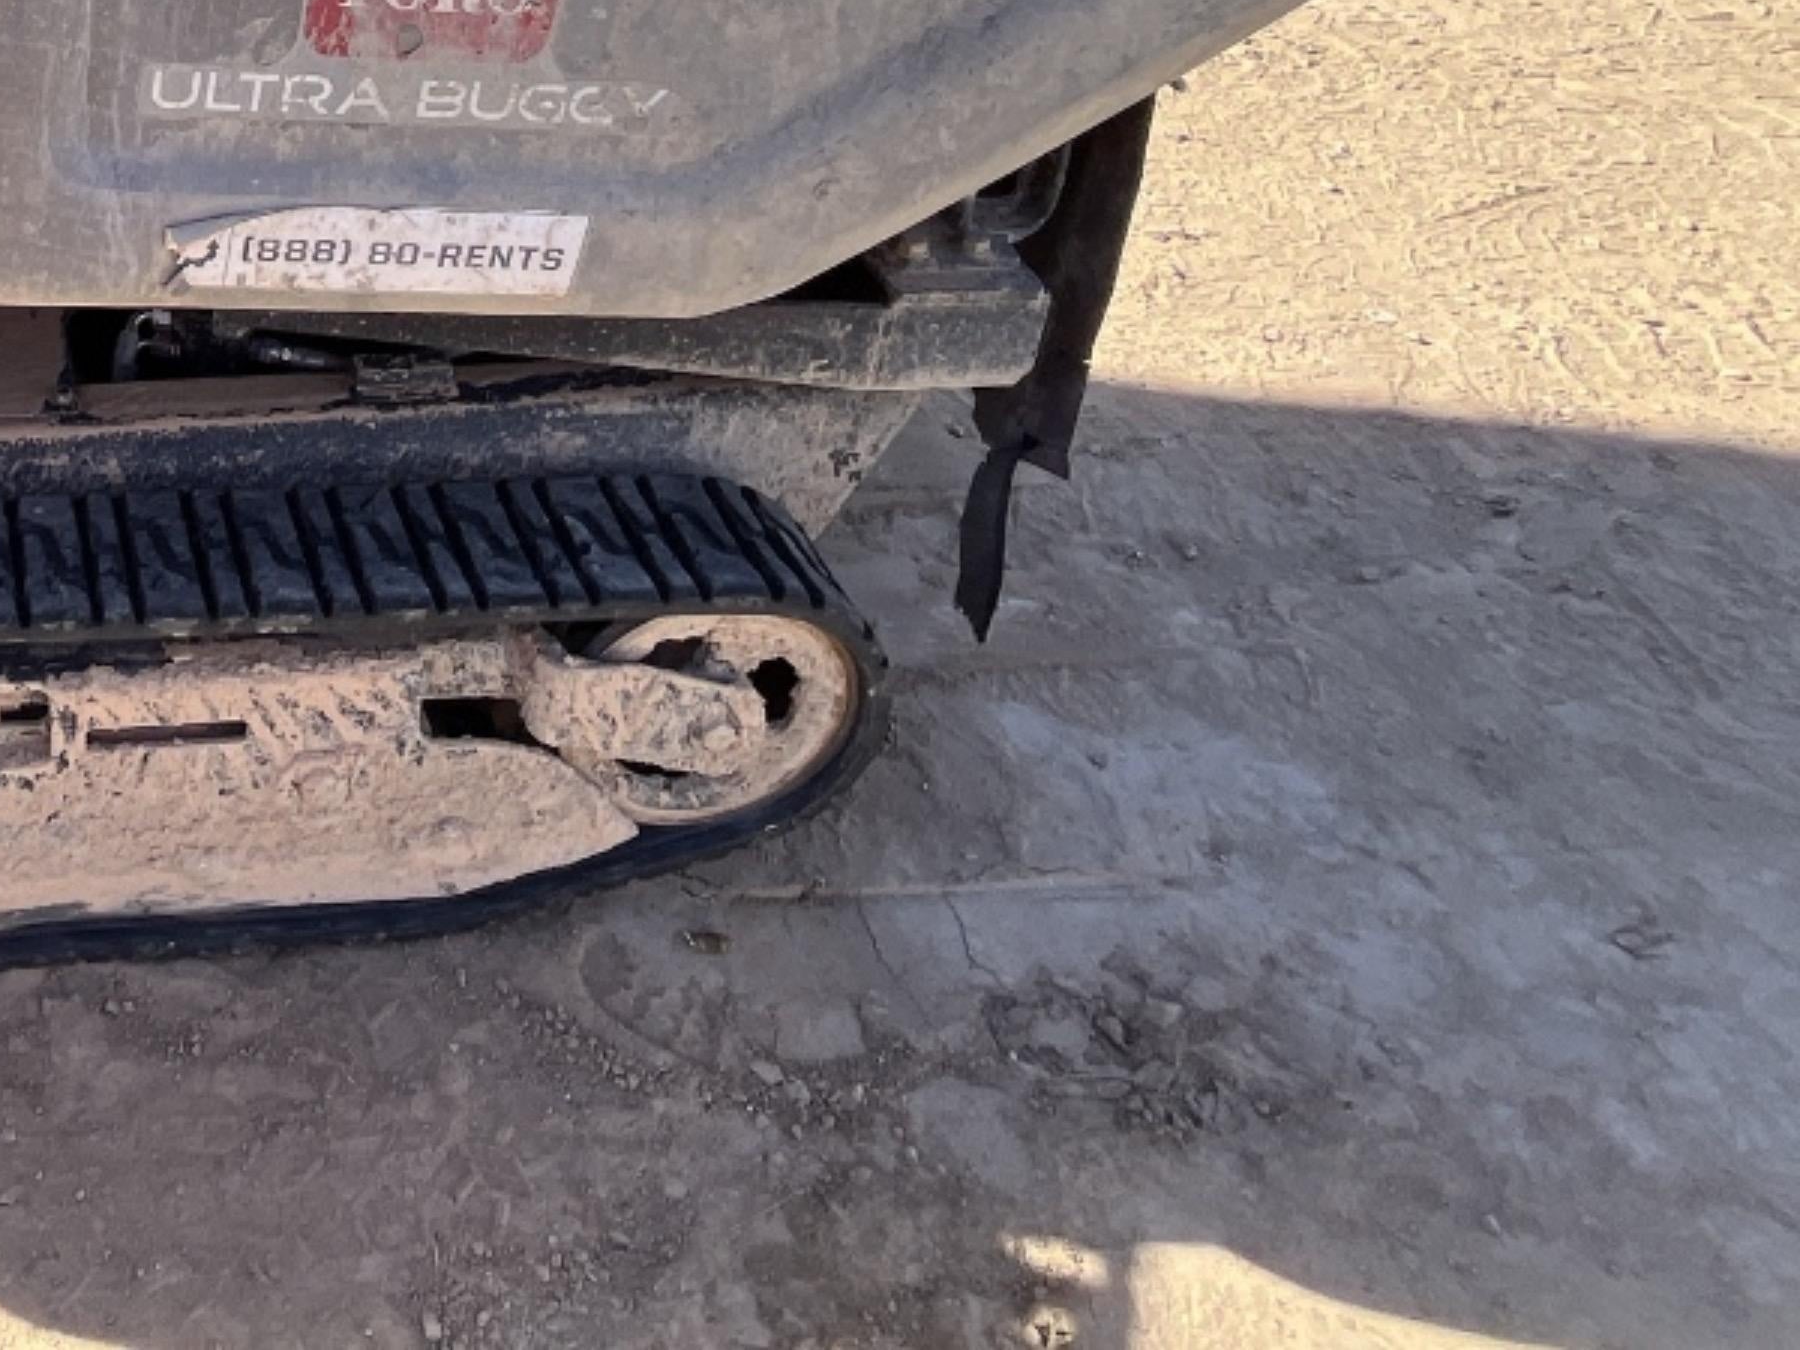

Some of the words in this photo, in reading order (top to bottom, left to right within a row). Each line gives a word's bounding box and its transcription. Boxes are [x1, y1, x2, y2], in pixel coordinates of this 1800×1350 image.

[151, 71, 388, 119] ULTRA
[241, 238, 352, 265] (888)
[368, 239, 565, 271] 80-RENTS
